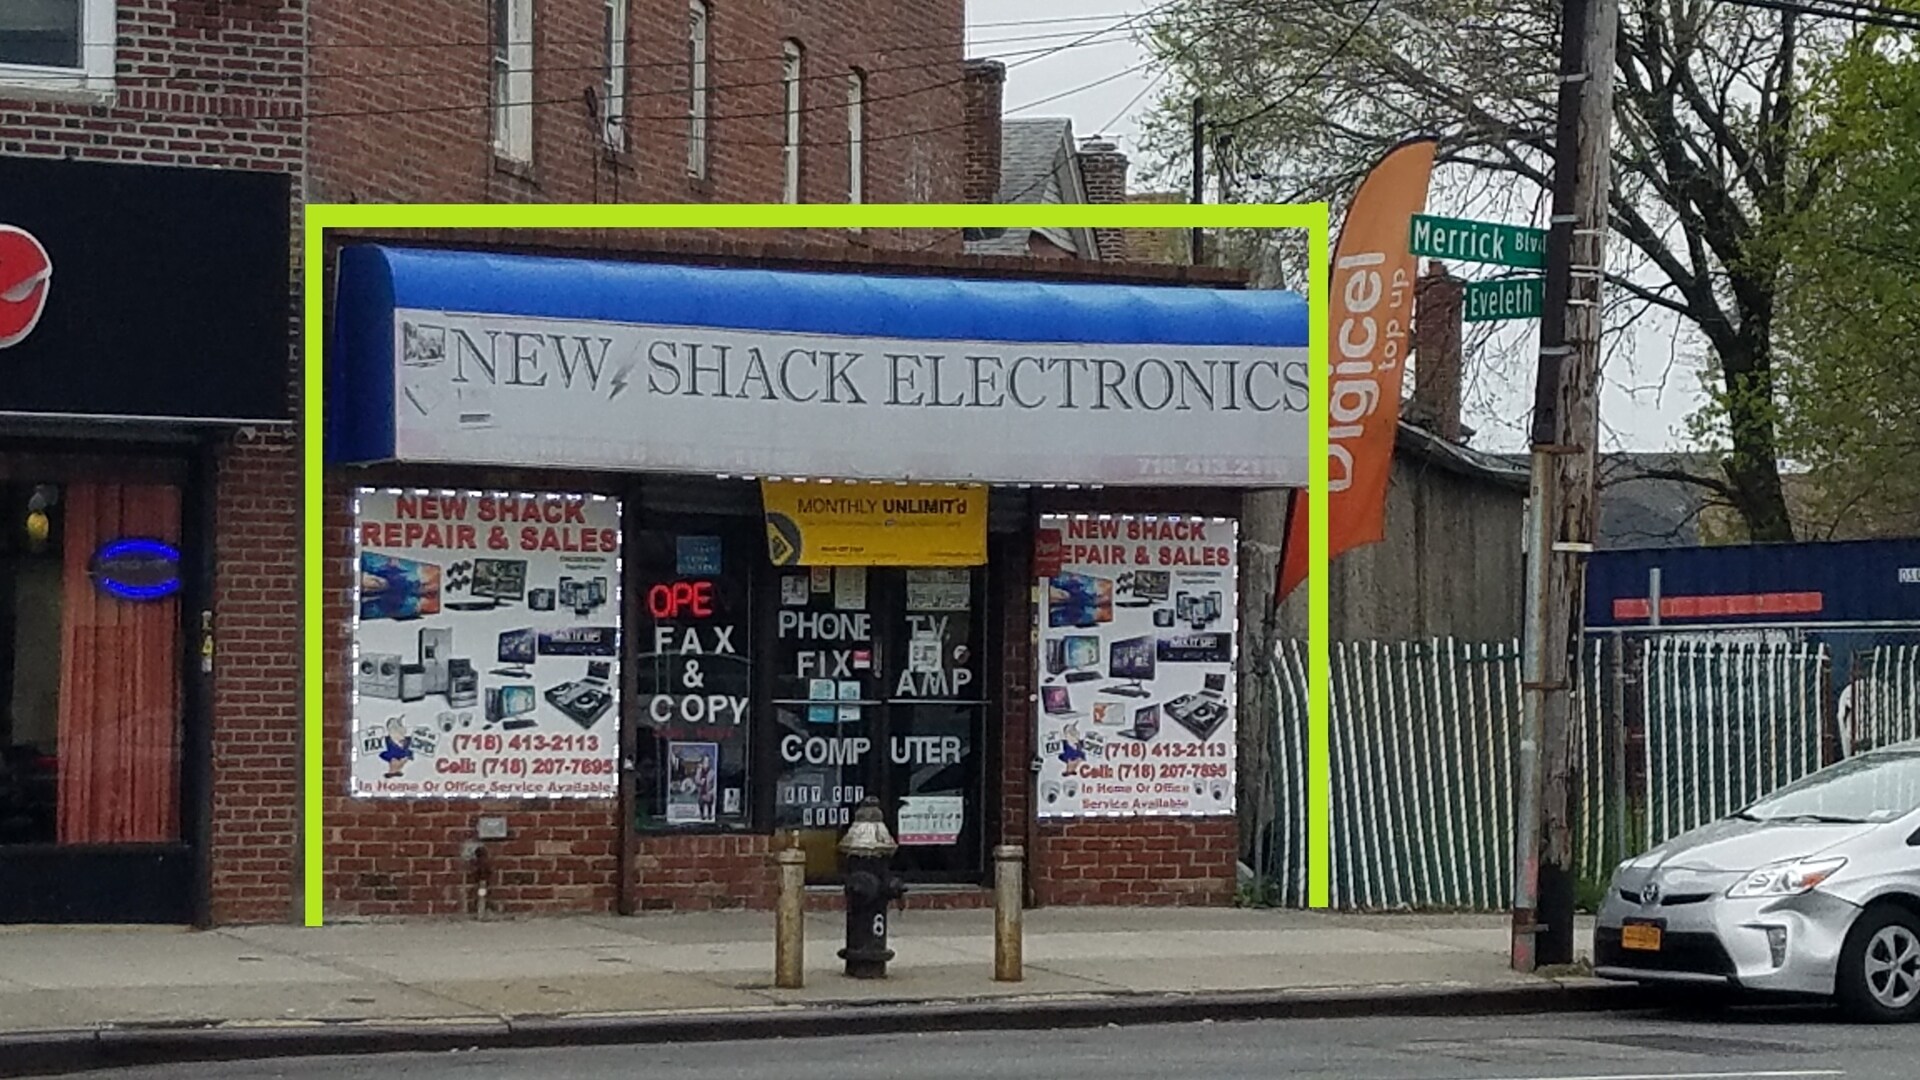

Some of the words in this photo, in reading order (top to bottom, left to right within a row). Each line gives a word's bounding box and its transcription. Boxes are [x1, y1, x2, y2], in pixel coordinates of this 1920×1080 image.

[1414, 219, 1505, 260] Merrick
[1390, 268, 1409, 308] up
[1471, 282, 1532, 316] Eveleth
[1378, 319, 1405, 370] top
[451, 328, 612, 391] NEW
[648, 340, 867, 404] SHACK
[884, 353, 1309, 413] ELECTRONICS
[1306, 252, 1386, 493] Digicel
[396, 496, 469, 521] NEW
[477, 499, 586, 524] SHACK
[797, 498, 878, 515] MONTHLY
[361, 522, 477, 549] REPAIR
[488, 526, 509, 551] &
[520, 527, 618, 552] SALES
[1068, 520, 1120, 540] NEW
[1127, 521, 1206, 541] SHACK
[1061, 545, 1126, 564] EPAIR
[1135, 546, 1150, 565] &
[1159, 547, 1230, 566] SALES
[778, 610, 871, 641] PHONE
[905, 615, 948, 641] TV
[655, 625, 735, 655] FAX
[682, 659, 705, 689] &
[797, 650, 852, 678] FIX
[895, 668, 972, 696] AMP
[649, 695, 750, 724] COPY
[452, 734, 503, 754] (718)
[508, 734, 599, 751] 413-2113
[781, 733, 872, 765] COMP
[891, 735, 962, 764] UTER
[1105, 743, 1147, 761] (718)
[1152, 743, 1226, 757] 413-2113
[482, 757, 527, 778] (718)
[1118, 764, 1156, 782] (718)
[359, 781, 372, 791] In
[377, 781, 419, 792] Home
[423, 781, 440, 791] Or
[444, 781, 486, 792] Office
[490, 781, 543, 792] Service
[548, 781, 611, 792] Available
[1082, 783, 1092, 793] In
[1097, 783, 1132, 793] Home
[1136, 783, 1151, 793] Or
[1154, 783, 1190, 793] Office
[1082, 798, 1129, 809] Service
[1132, 798, 1189, 809] Available
[873, 913, 884, 937] 8
